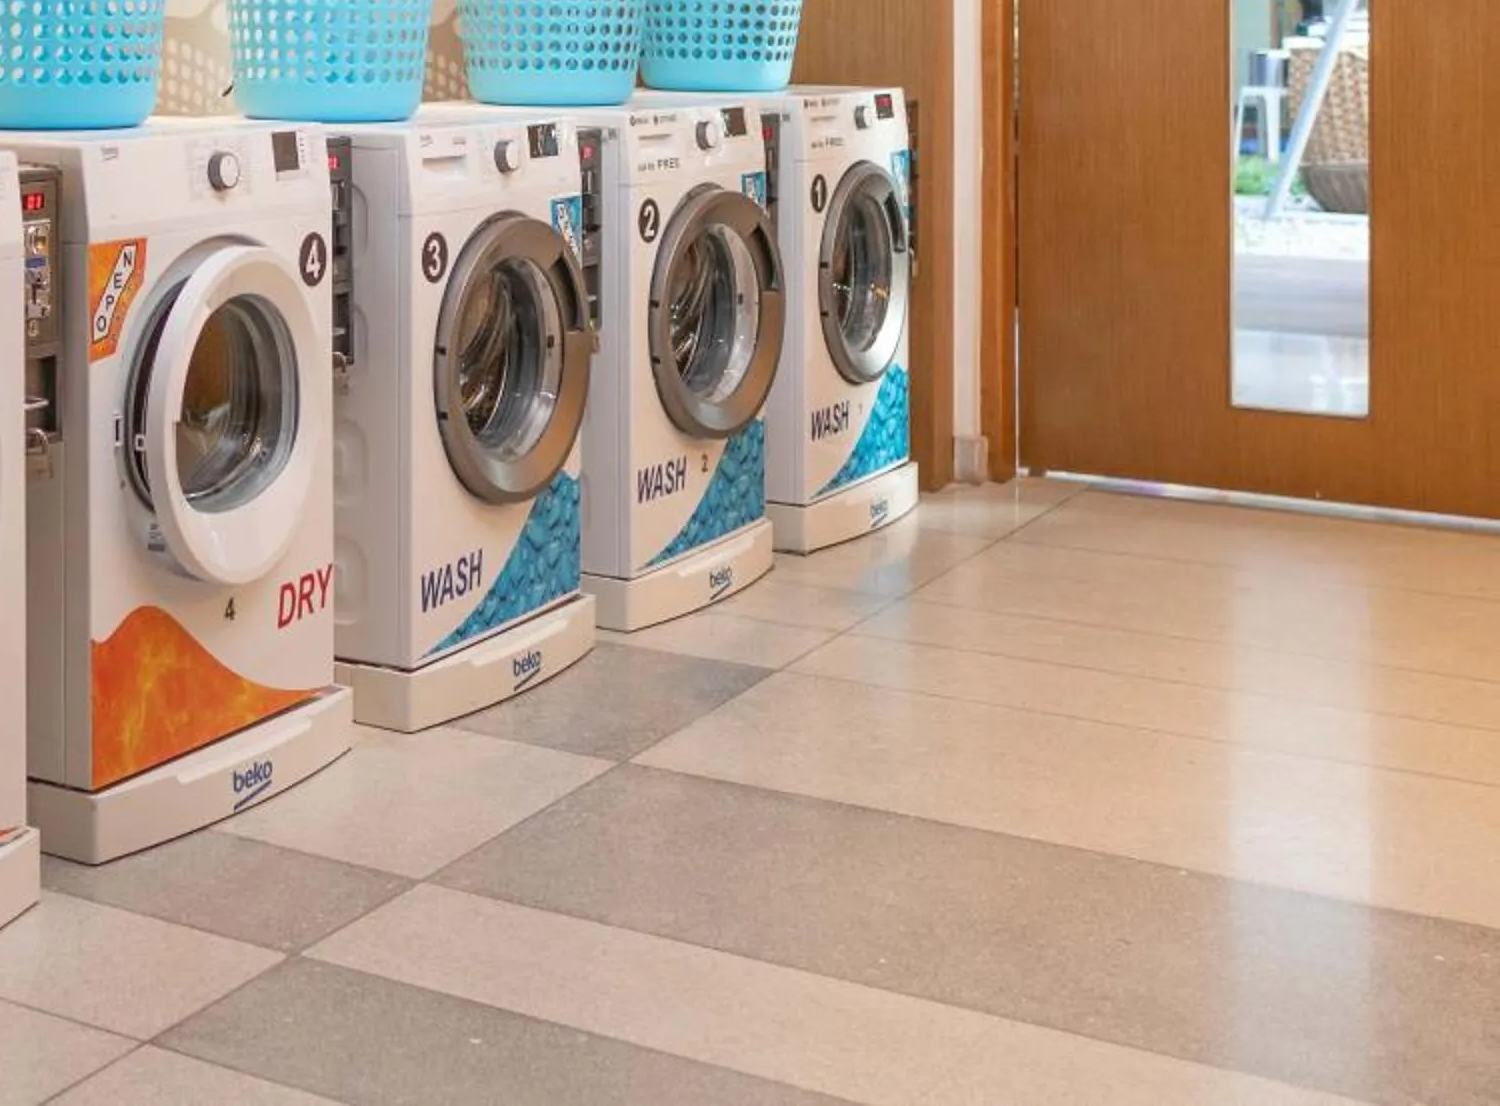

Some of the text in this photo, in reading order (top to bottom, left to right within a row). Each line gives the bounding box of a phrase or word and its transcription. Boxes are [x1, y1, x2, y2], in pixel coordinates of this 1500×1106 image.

[642, 205, 656, 238] 2
[305, 238, 321, 279] 4
[427, 238, 442, 278] 3
[96, 251, 133, 332] OPEN
[811, 398, 851, 443] WASH
[637, 454, 688, 505] WASH
[277, 562, 334, 629] DRY
[420, 547, 483, 614] WASH
[224, 596, 237, 621] 4
[512, 649, 542, 678] beko
[232, 760, 273, 794] beko
